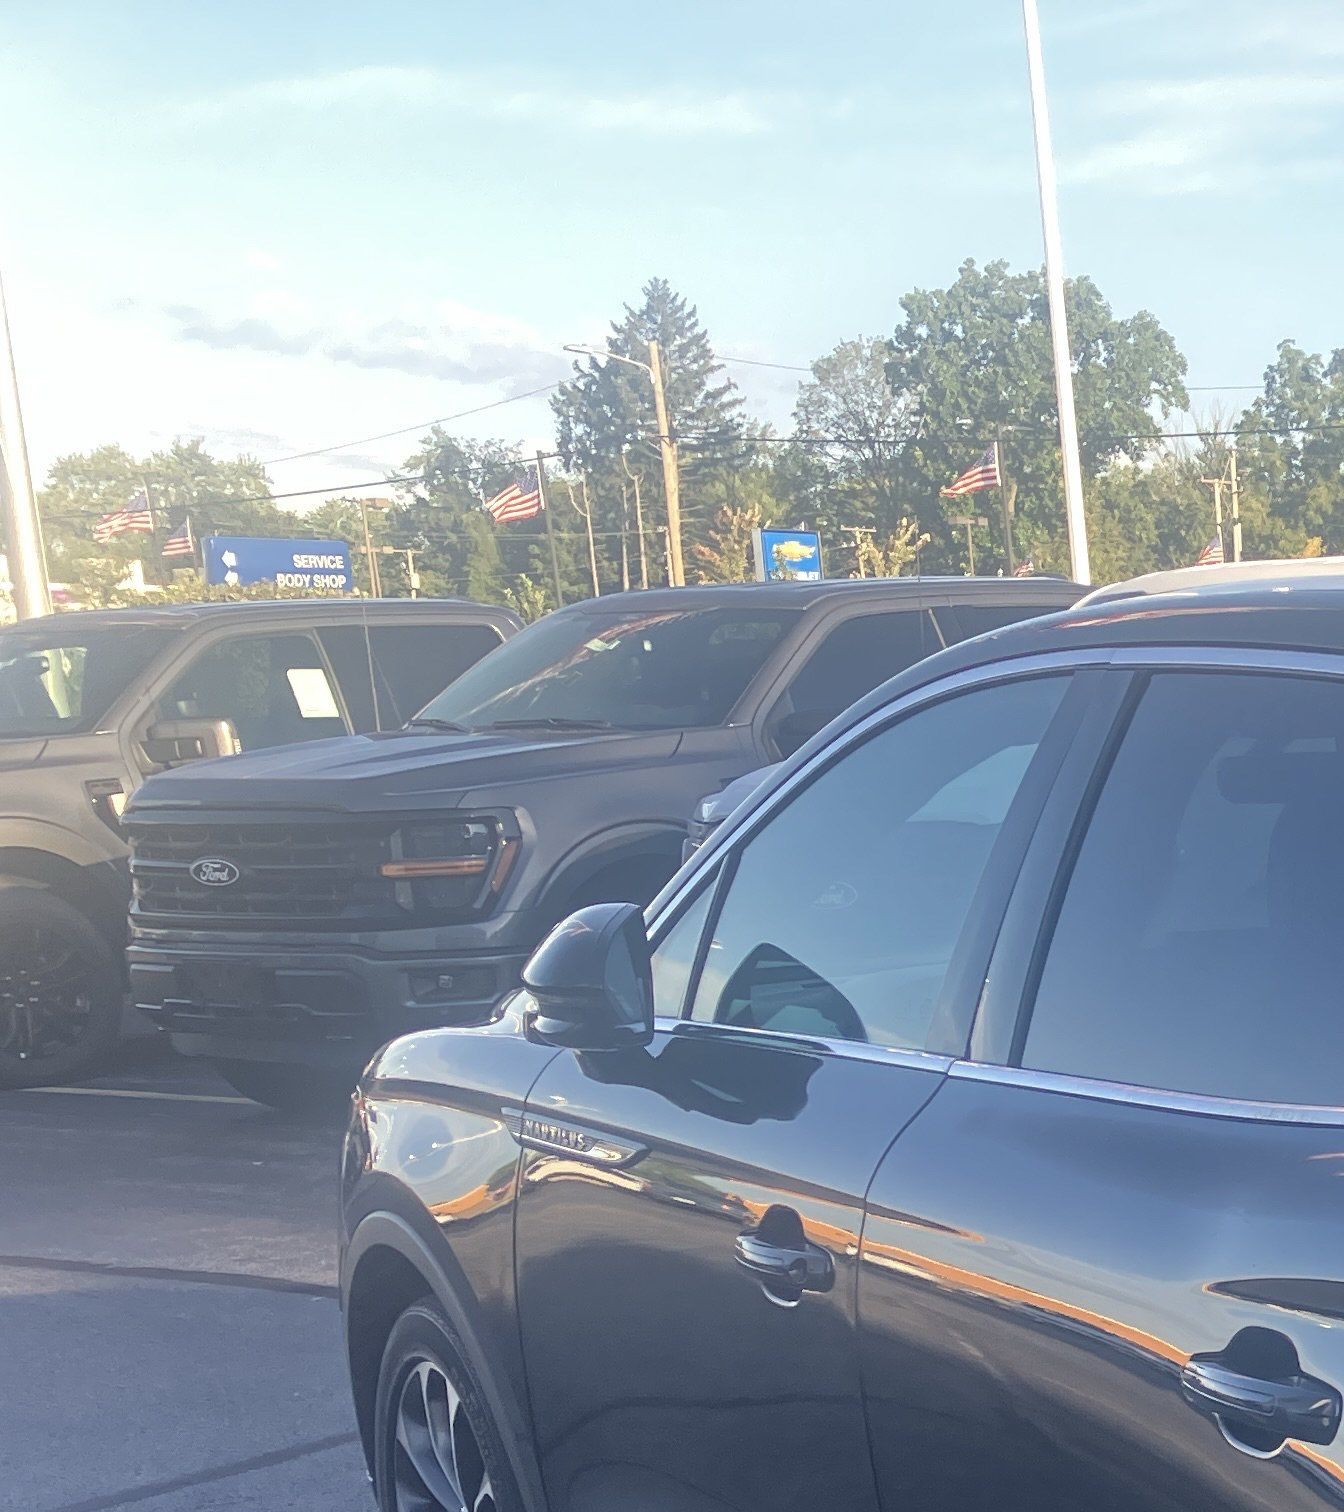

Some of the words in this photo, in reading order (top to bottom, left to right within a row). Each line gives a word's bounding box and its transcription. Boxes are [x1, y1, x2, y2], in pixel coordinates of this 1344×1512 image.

[293, 554, 344, 569] SERVICE
[276, 573, 311, 588] BODY
[313, 574, 347, 588] SHOP
[525, 1119, 586, 1150] NAUTILUS
